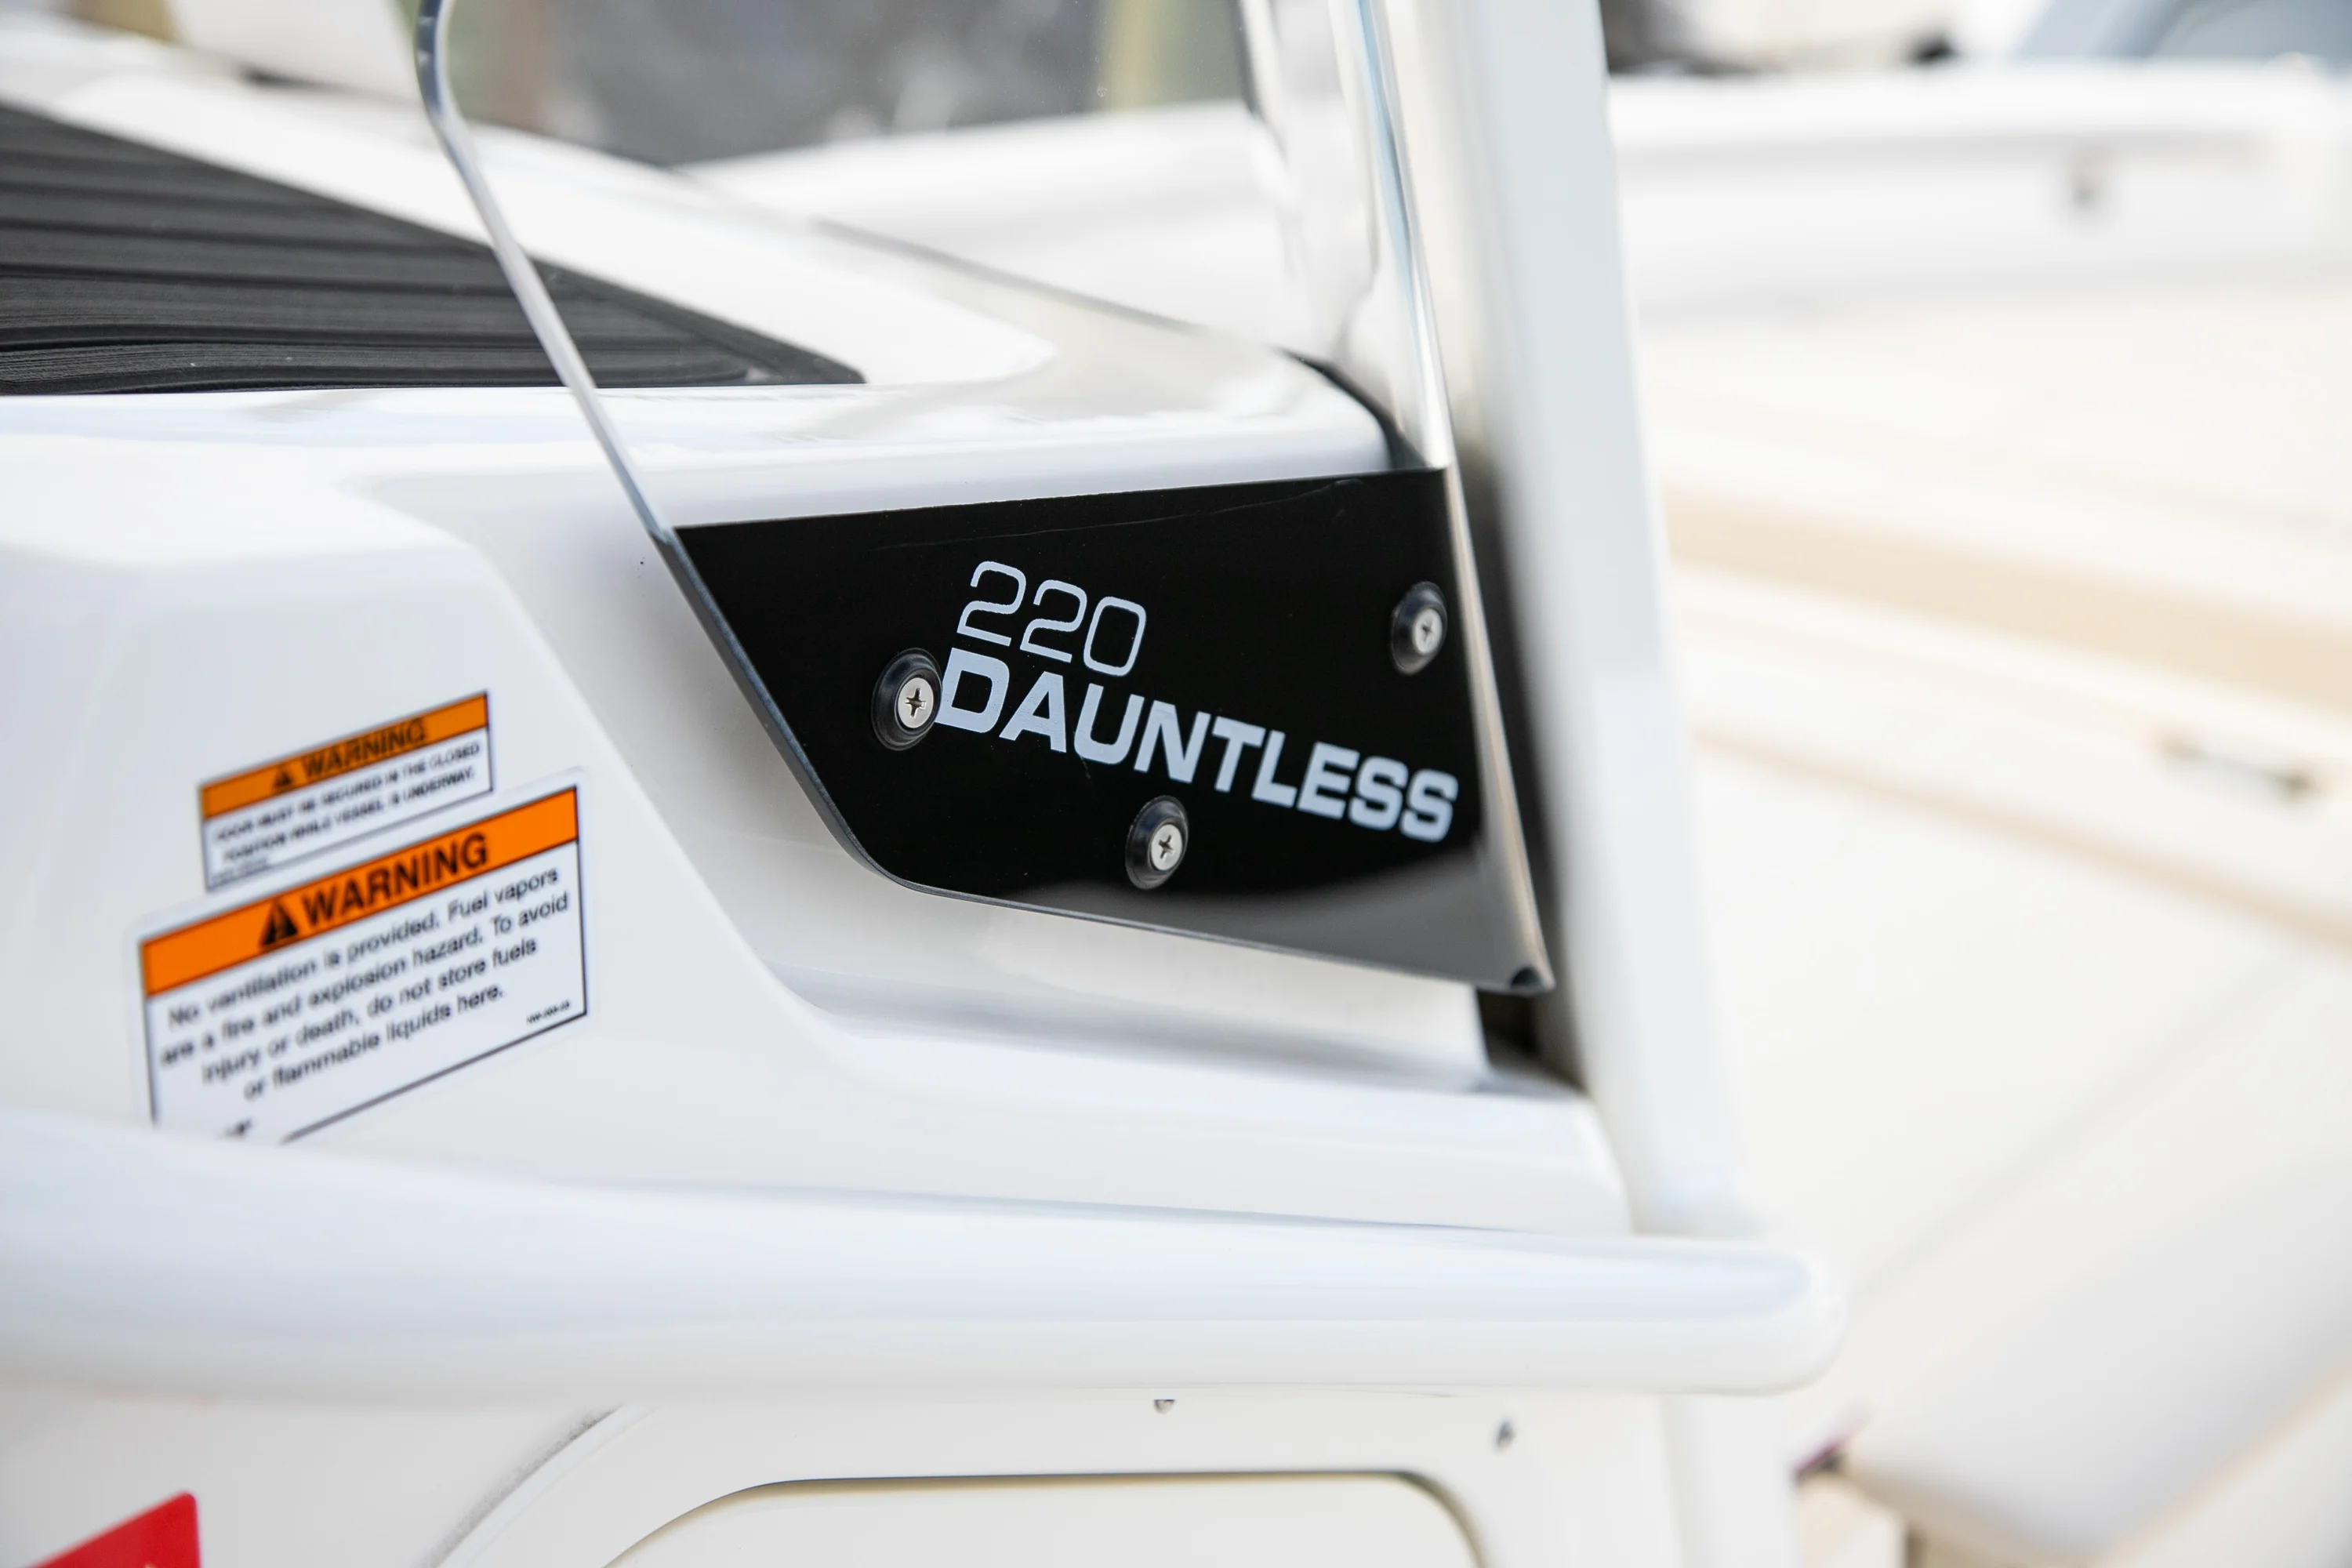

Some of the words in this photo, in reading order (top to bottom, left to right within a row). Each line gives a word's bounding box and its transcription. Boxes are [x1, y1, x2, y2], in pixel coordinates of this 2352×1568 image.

[956, 560, 1147, 677] 220
[300, 717, 426, 779] WARNING
[429, 742, 481, 768] CLOSED
[935, 647, 1459, 844] DAUNTLESS
[301, 831, 488, 927] WARNING
[161, 1040, 194, 1069] are
[201, 1030, 214, 1051] a
[222, 1016, 255, 1041] fire
[261, 993, 303, 1027] and
[307, 956, 406, 1011] explosion
[412, 926, 483, 967] hazard.
[492, 915, 512, 935] To
[518, 891, 569, 927] avoid
[168, 1004, 200, 1032] No
[206, 958, 318, 1013] ventilation
[323, 948, 341, 969] is
[347, 911, 439, 966] provided.
[448, 889, 488, 922] Fuel
[494, 868, 557, 905] vapors
[201, 1047, 261, 1086] injury
[267, 1035, 288, 1058] or
[295, 1009, 360, 1047] death,
[367, 996, 393, 1018] do
[399, 978, 432, 1004] not
[438, 957, 486, 990] store
[492, 938, 536, 970] fuels
[243, 1076, 267, 1102] or
[273, 1029, 379, 1089] flammable
[386, 1004, 452, 1042] liquids
[457, 983, 503, 1012] here.
